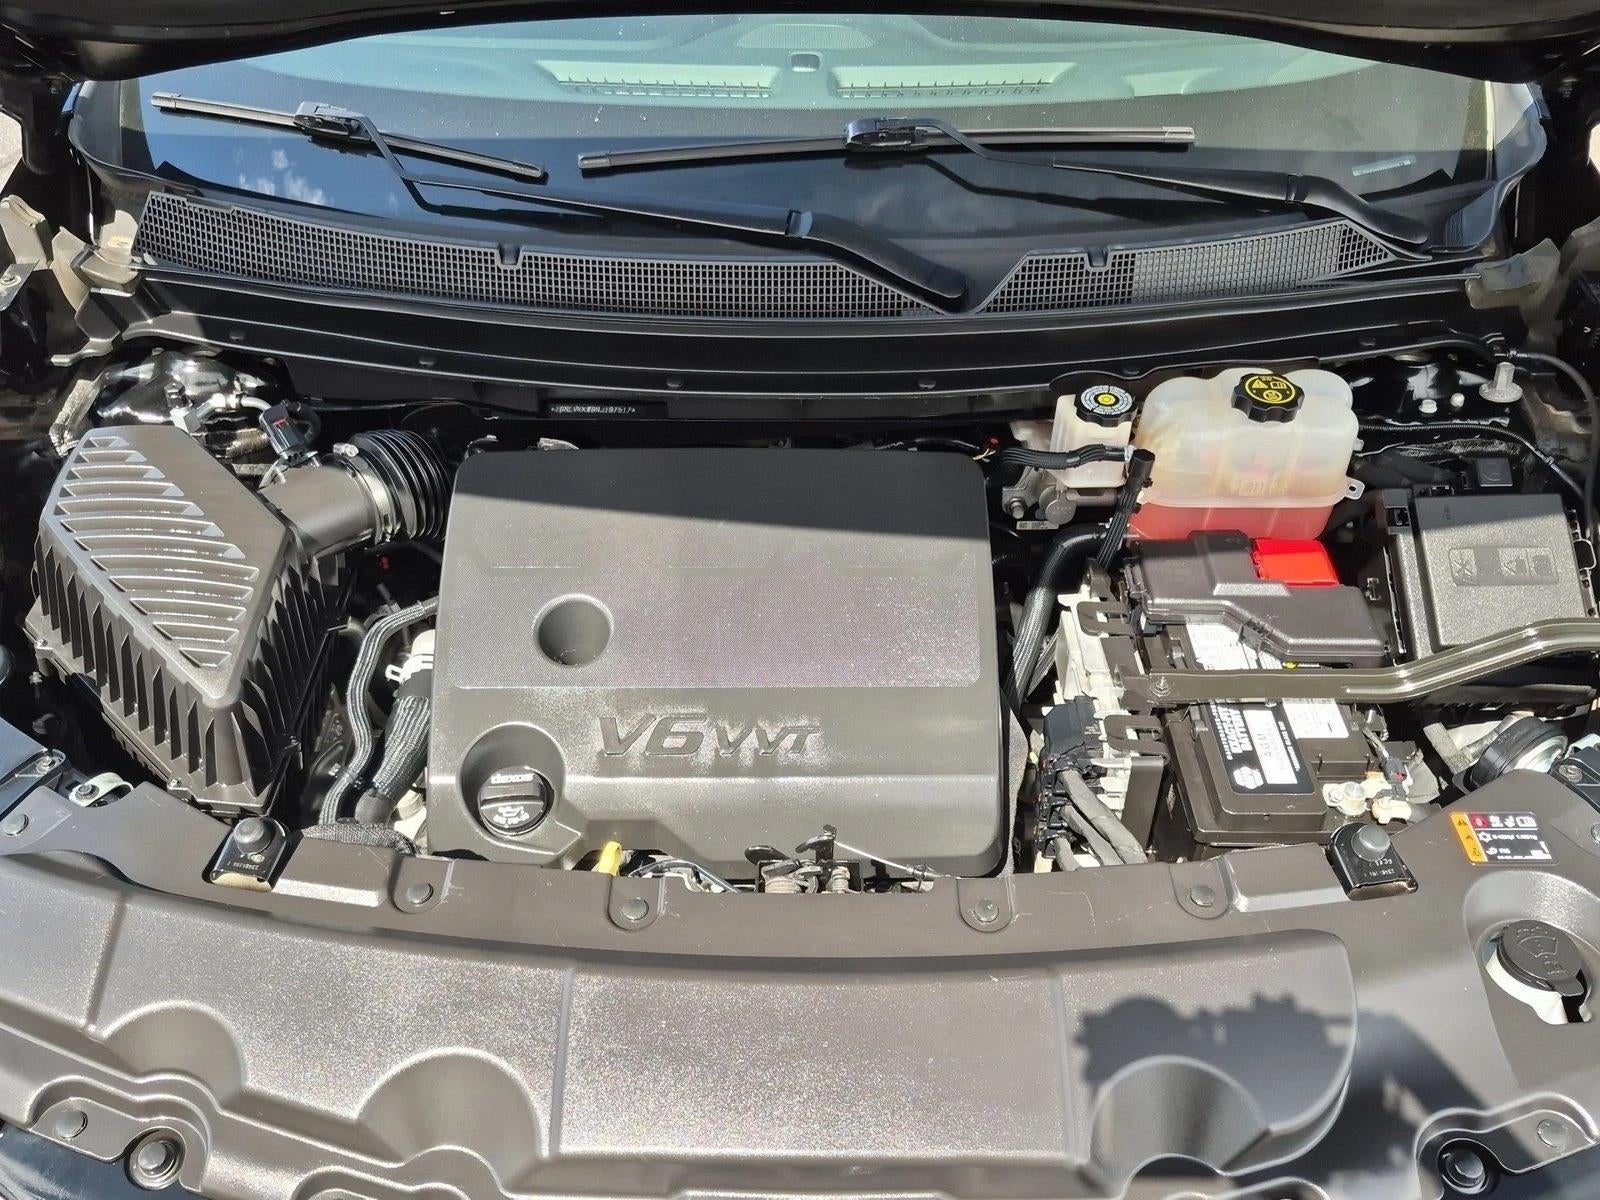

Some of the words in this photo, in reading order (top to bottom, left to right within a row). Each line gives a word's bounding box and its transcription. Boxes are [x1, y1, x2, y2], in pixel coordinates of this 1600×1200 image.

[599, 713, 707, 756] V6
[715, 726, 822, 756] VVT
[1229, 708, 1253, 750] BATTERY
